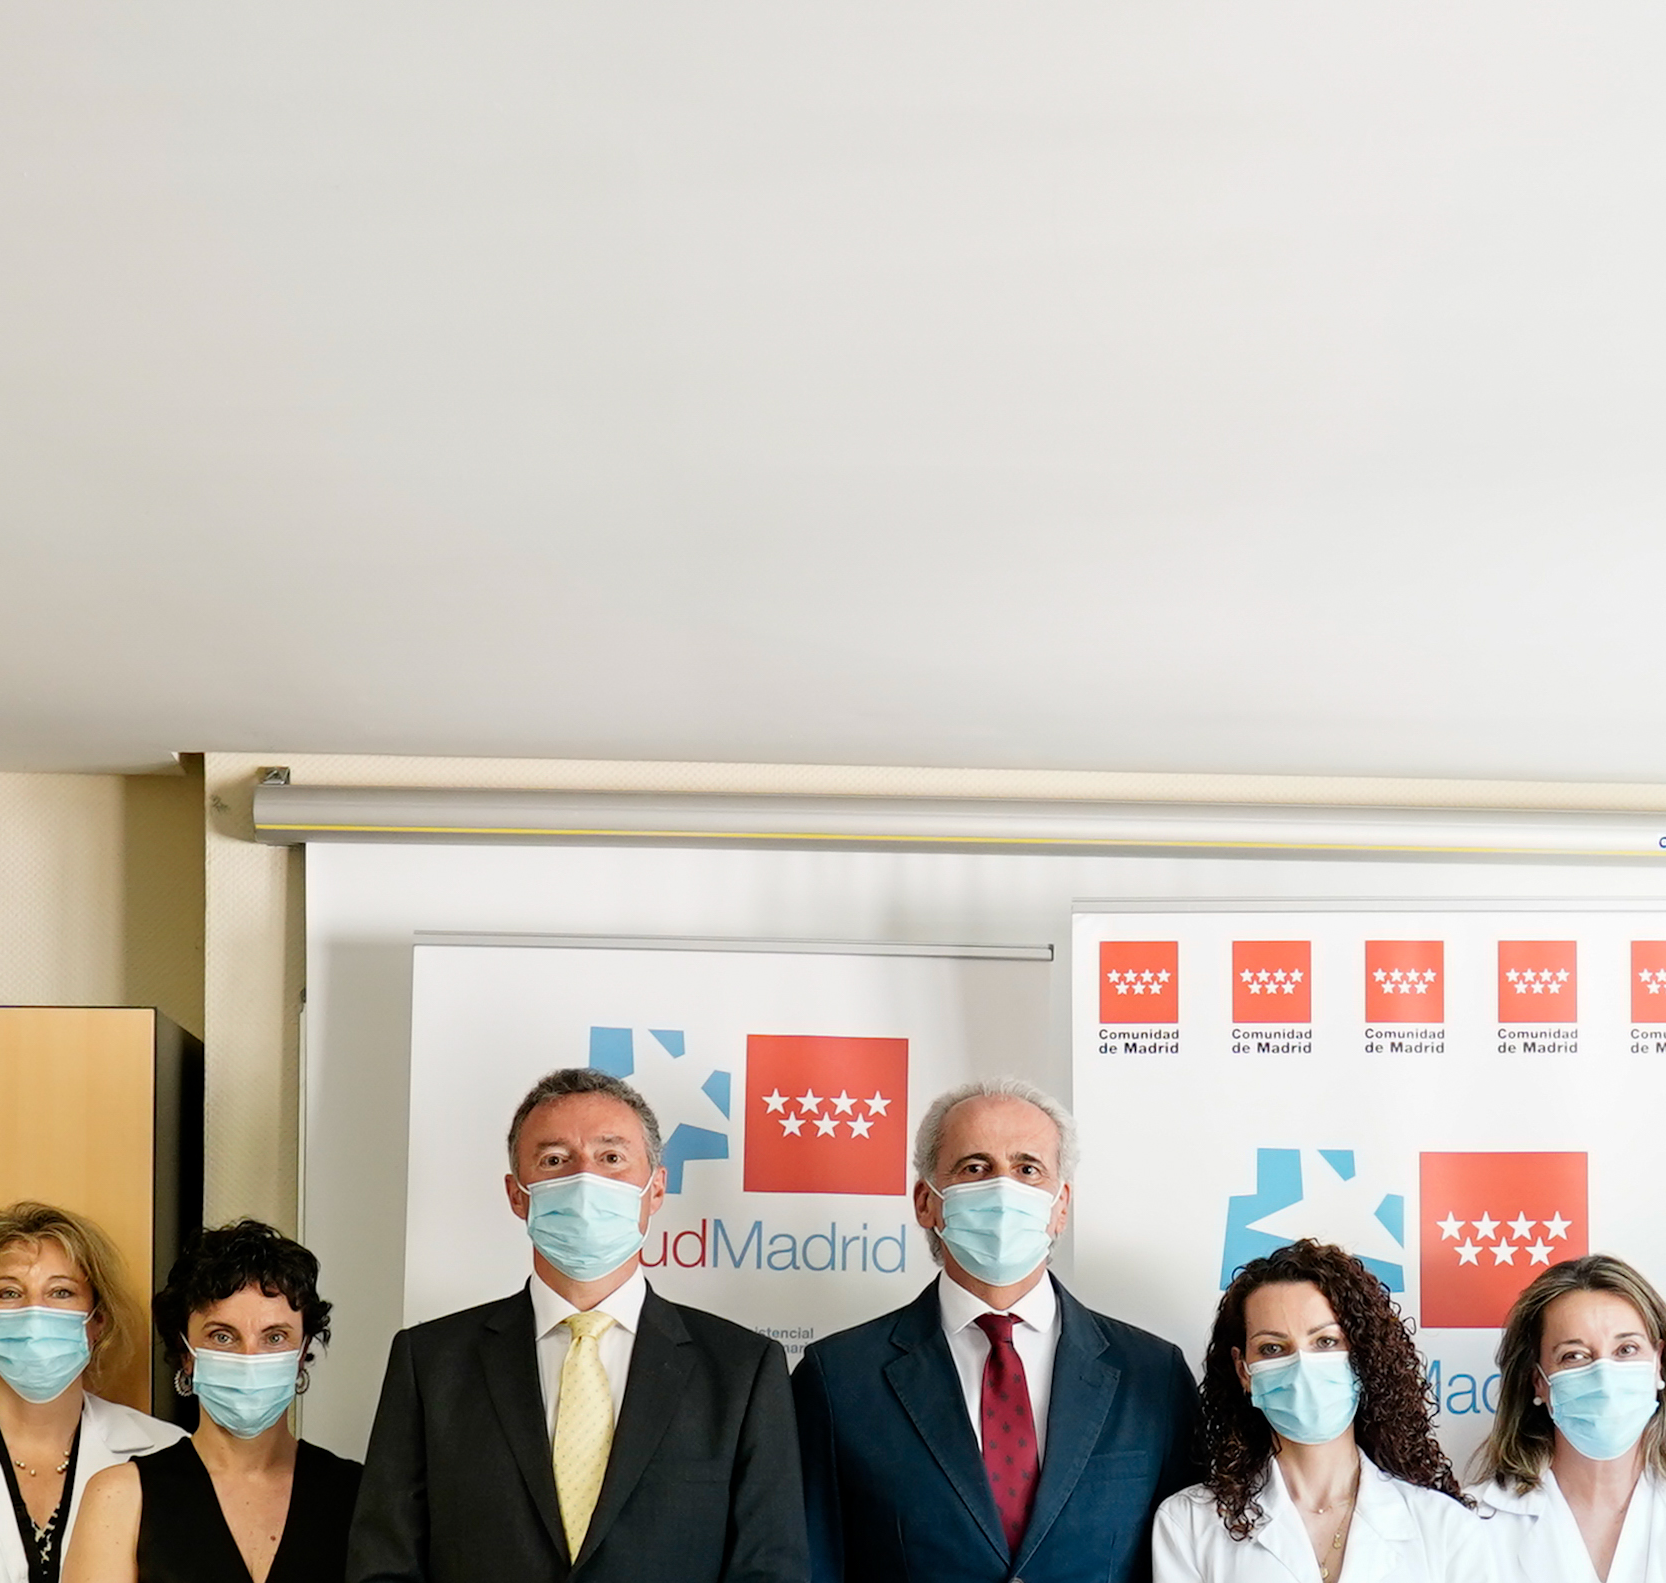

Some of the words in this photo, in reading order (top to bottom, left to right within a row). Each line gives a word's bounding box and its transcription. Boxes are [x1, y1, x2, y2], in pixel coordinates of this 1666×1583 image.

[1098, 1028, 1180, 1040] Comunidad
[1231, 1028, 1313, 1040] Comunidad
[1364, 1028, 1445, 1040] Comunidad
[1497, 1028, 1578, 1040] Comunidad
[1098, 1042, 1118, 1054] de
[1124, 1042, 1179, 1054] Madrid
[1231, 1042, 1251, 1054] de
[1256, 1042, 1312, 1054] Madrid
[1364, 1042, 1384, 1054] de
[1390, 1042, 1445, 1054] Madrid
[1497, 1042, 1517, 1054] de
[1522, 1042, 1578, 1054] Madrid
[1630, 1042, 1649, 1054] de
[638, 1218, 906, 1273] udMadrid
